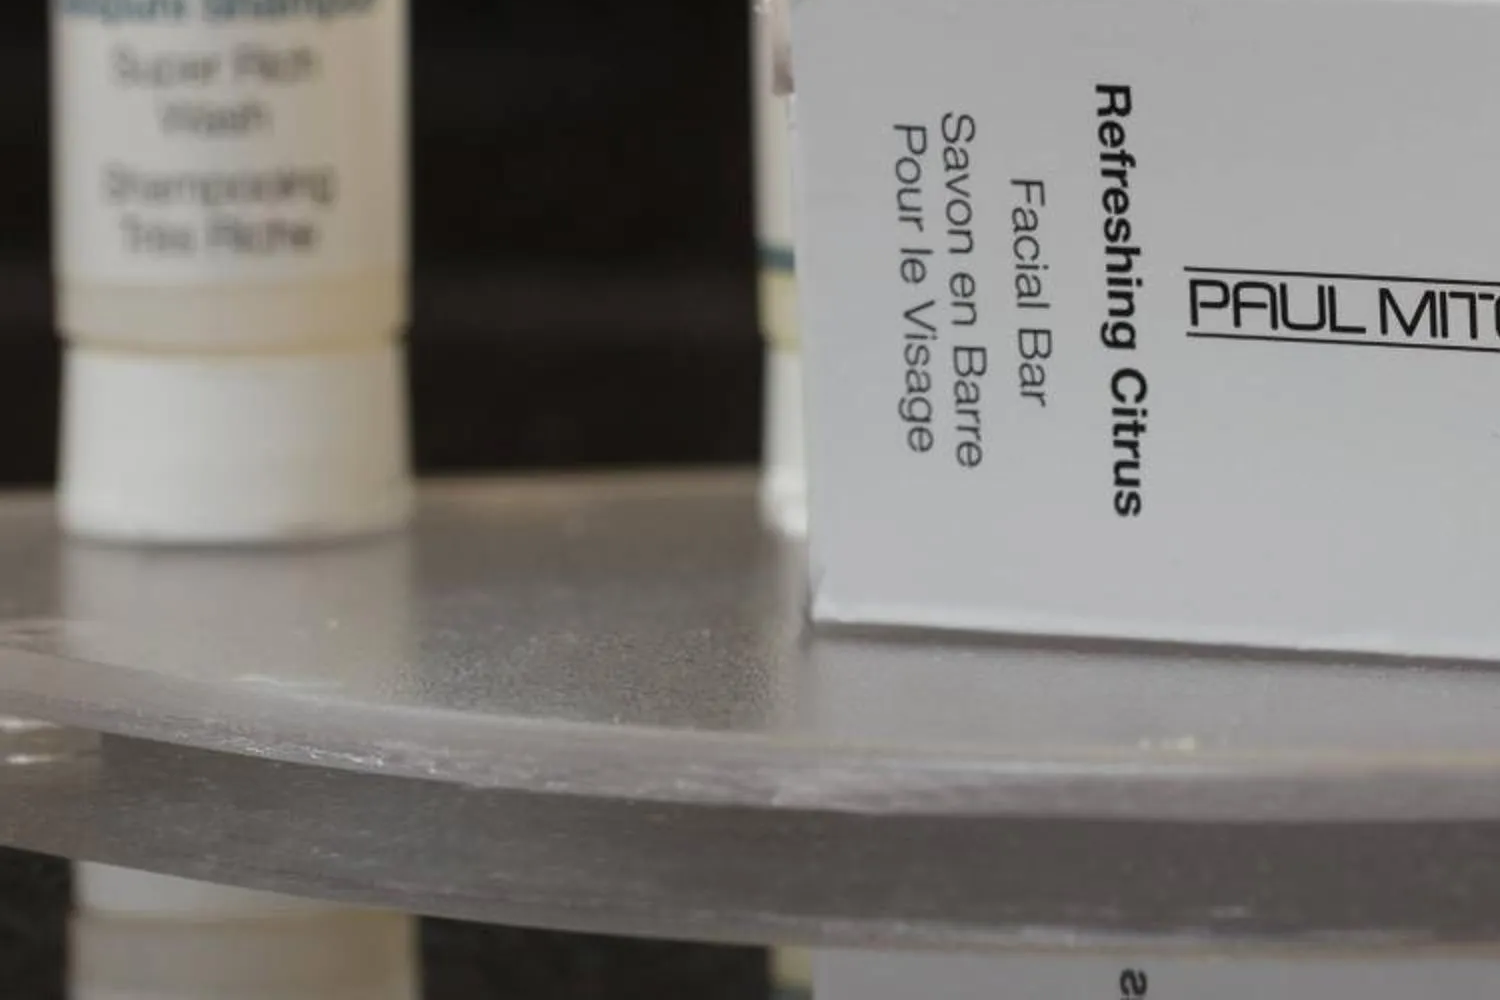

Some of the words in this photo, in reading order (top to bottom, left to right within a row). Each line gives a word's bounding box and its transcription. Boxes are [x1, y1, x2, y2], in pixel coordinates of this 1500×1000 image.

[893, 123, 927, 233] Pour
[941, 112, 976, 255] Savon
[1095, 84, 1142, 350] Refreshing
[899, 249, 934, 285] le
[949, 272, 979, 327] en
[1010, 178, 1050, 309] Facial
[1189, 278, 1367, 335] PAUL
[898, 300, 937, 453] Visage
[952, 347, 987, 468] Barre
[1017, 328, 1052, 408] Bar
[1111, 367, 1147, 517] Citrus
